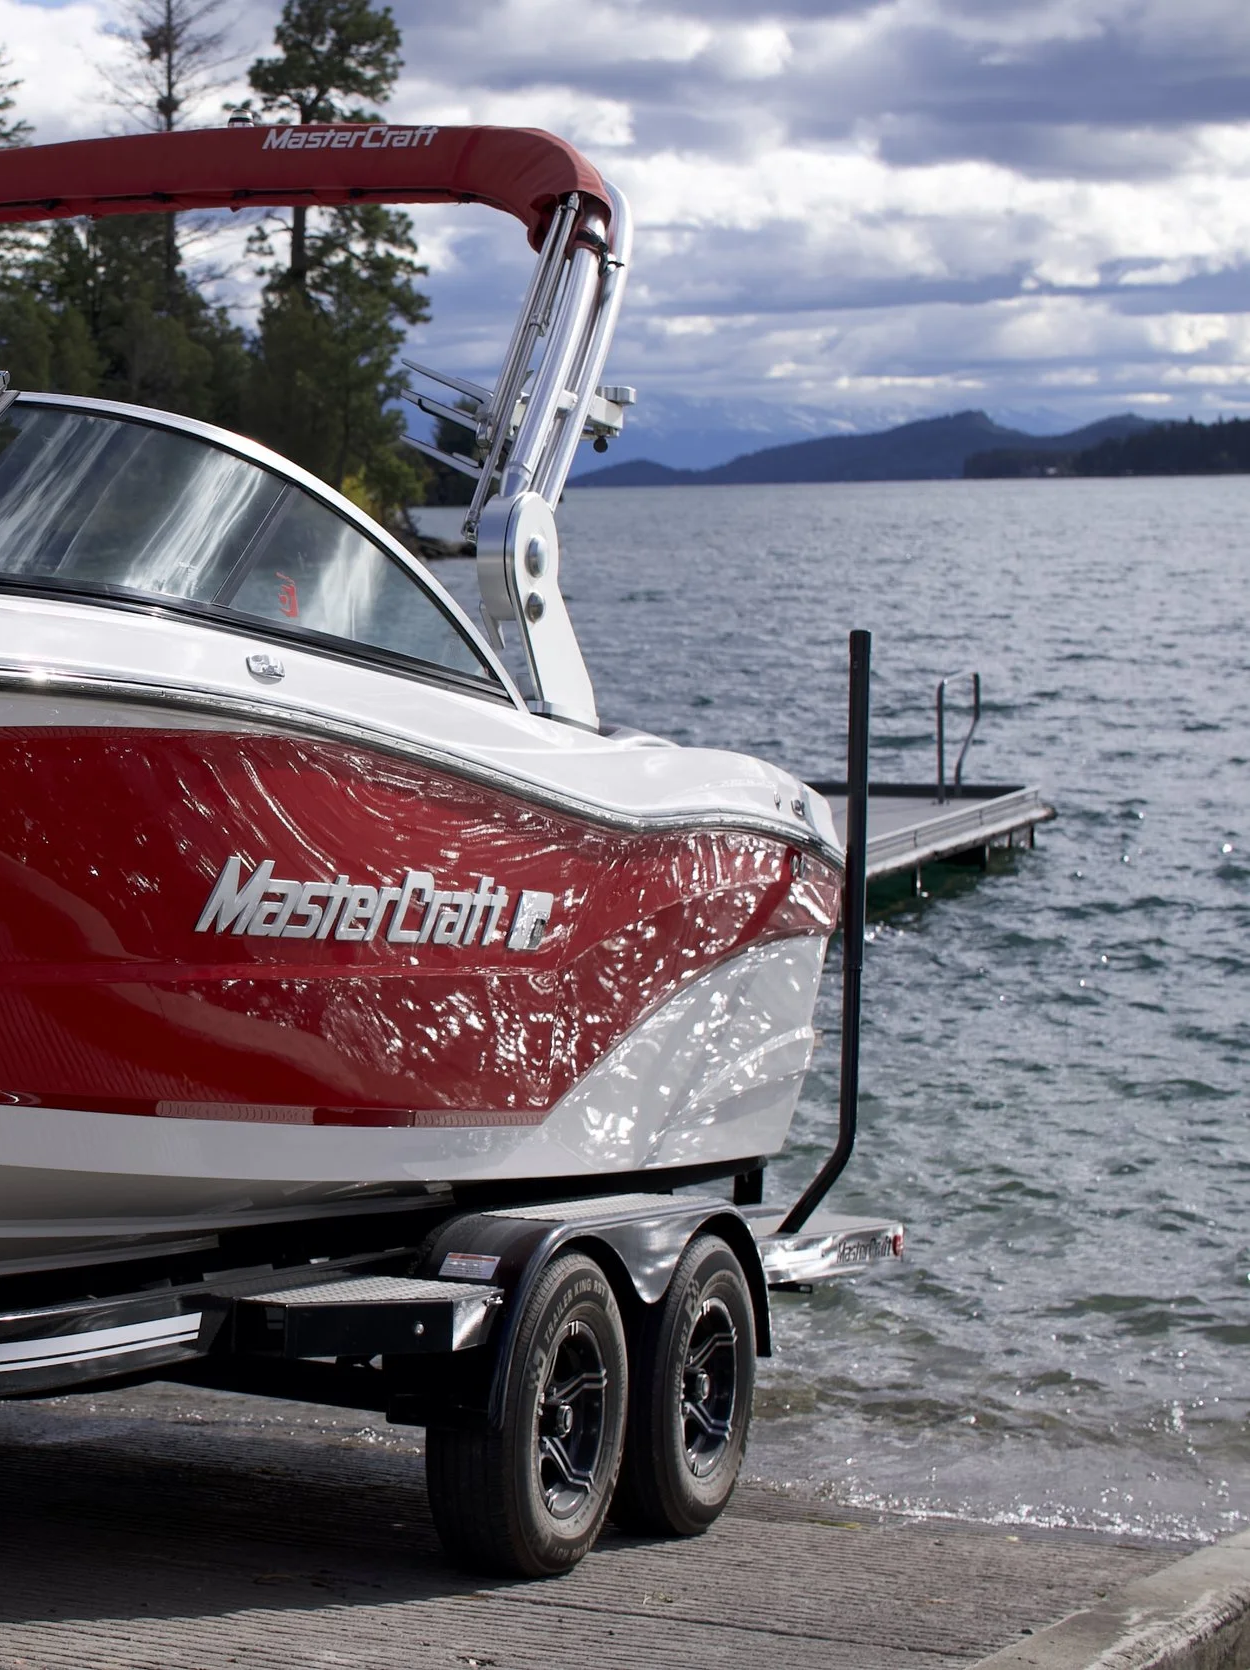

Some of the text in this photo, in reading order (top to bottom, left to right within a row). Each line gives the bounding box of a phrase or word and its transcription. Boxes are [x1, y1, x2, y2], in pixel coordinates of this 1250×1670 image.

[262, 125, 439, 150] MasterCraft
[195, 856, 509, 947] MasterCraft
[544, 1278, 607, 1344] TRAILER KING RST
